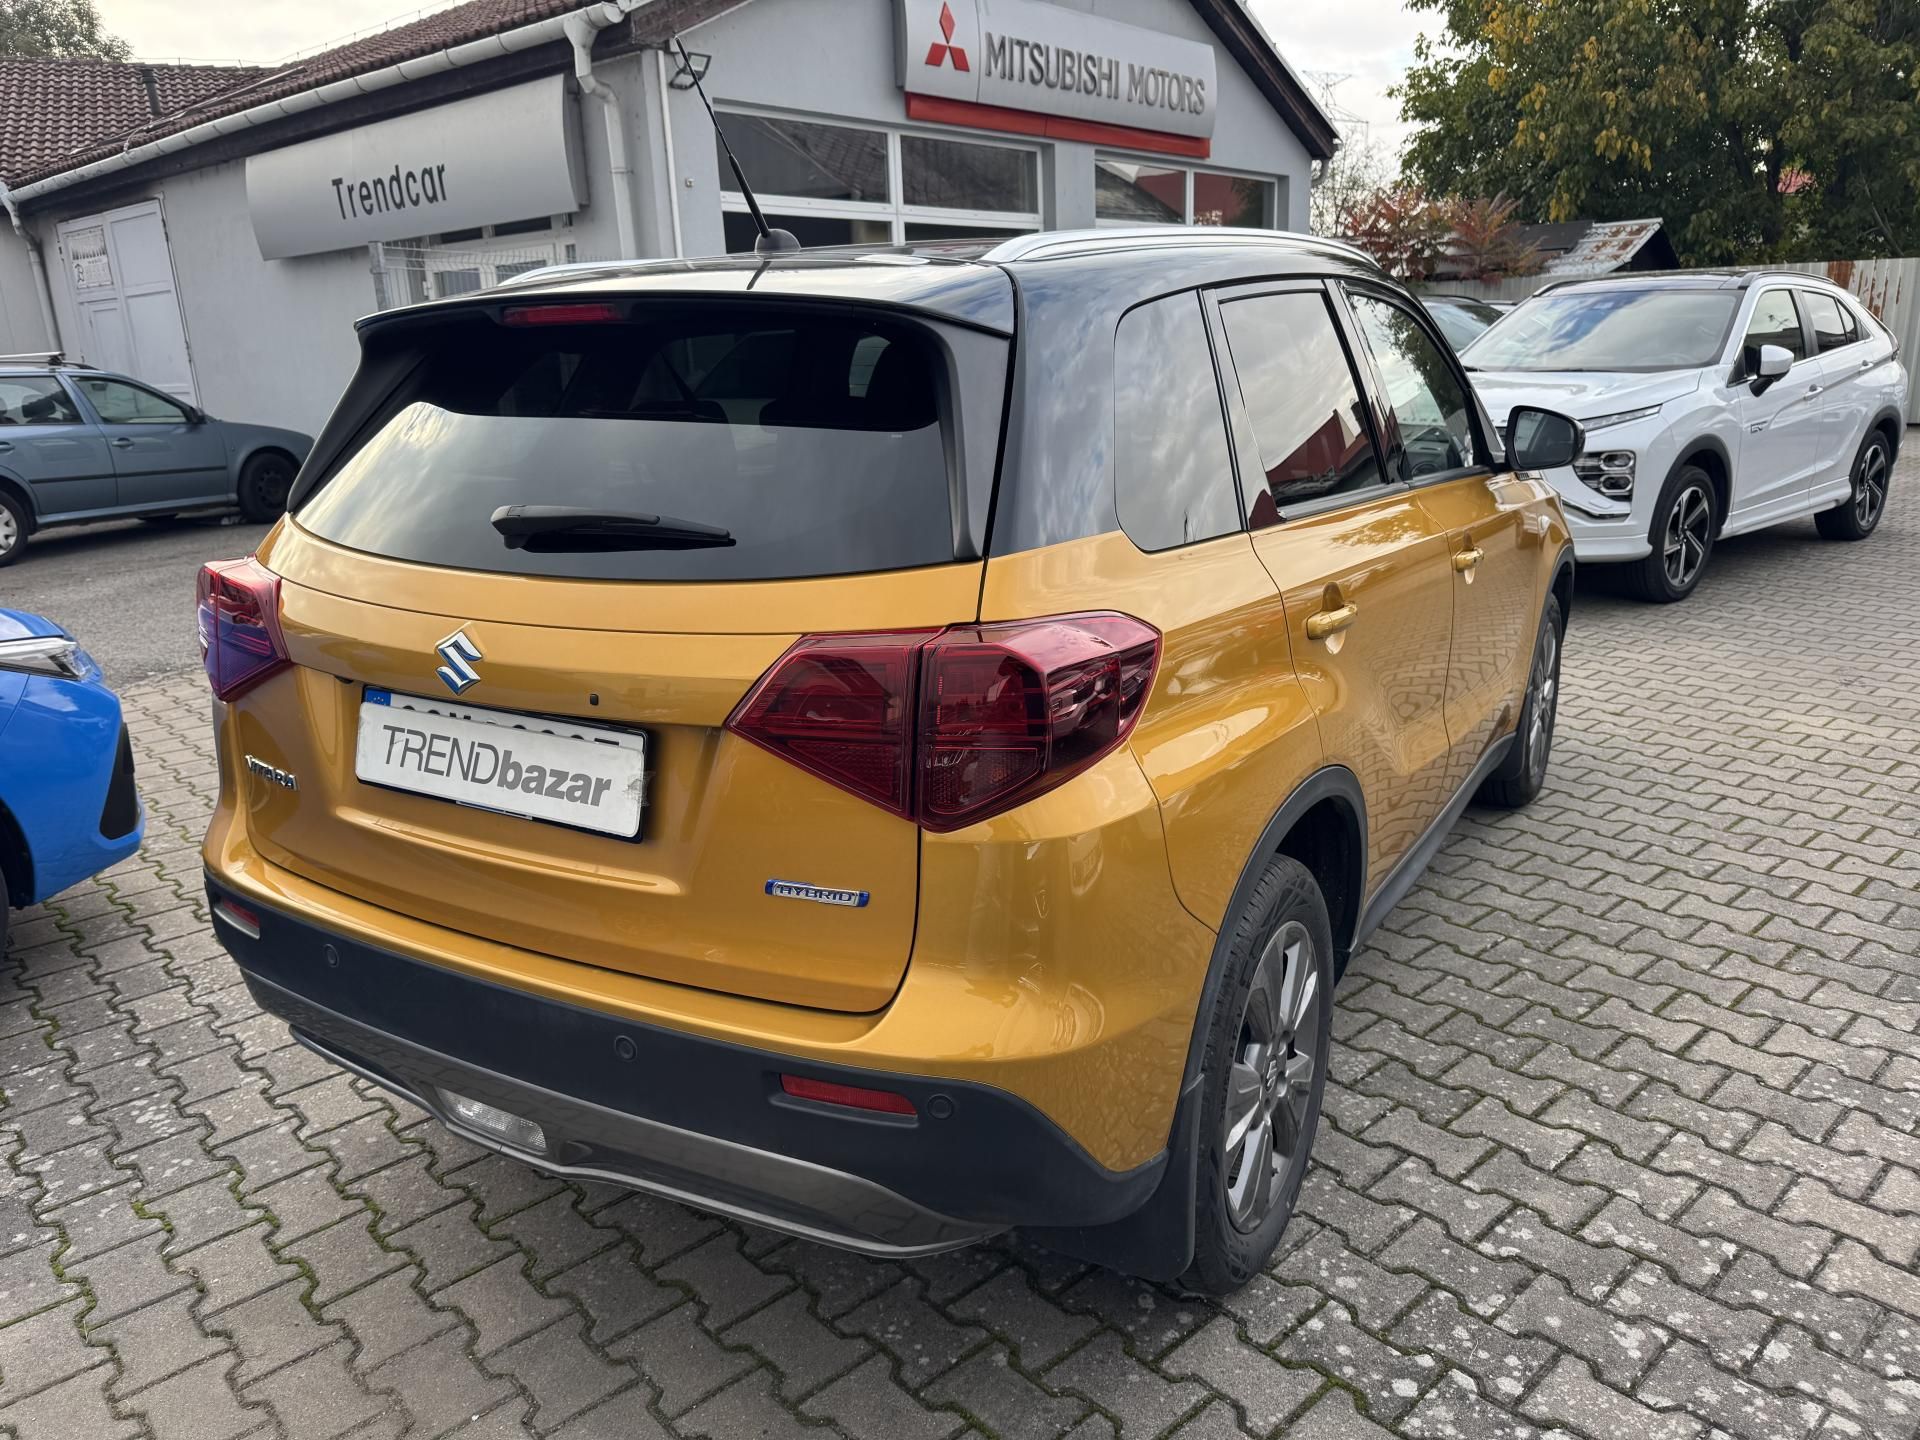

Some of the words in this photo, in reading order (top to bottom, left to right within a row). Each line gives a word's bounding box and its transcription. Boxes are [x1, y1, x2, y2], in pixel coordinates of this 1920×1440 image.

[984, 31, 1120, 99] MITSUBISHI
[1127, 63, 1206, 115] MOTORS
[331, 164, 447, 220] Trendcar
[382, 724, 613, 807] TRENDbazar
[779, 884, 853, 902] HYBRID
